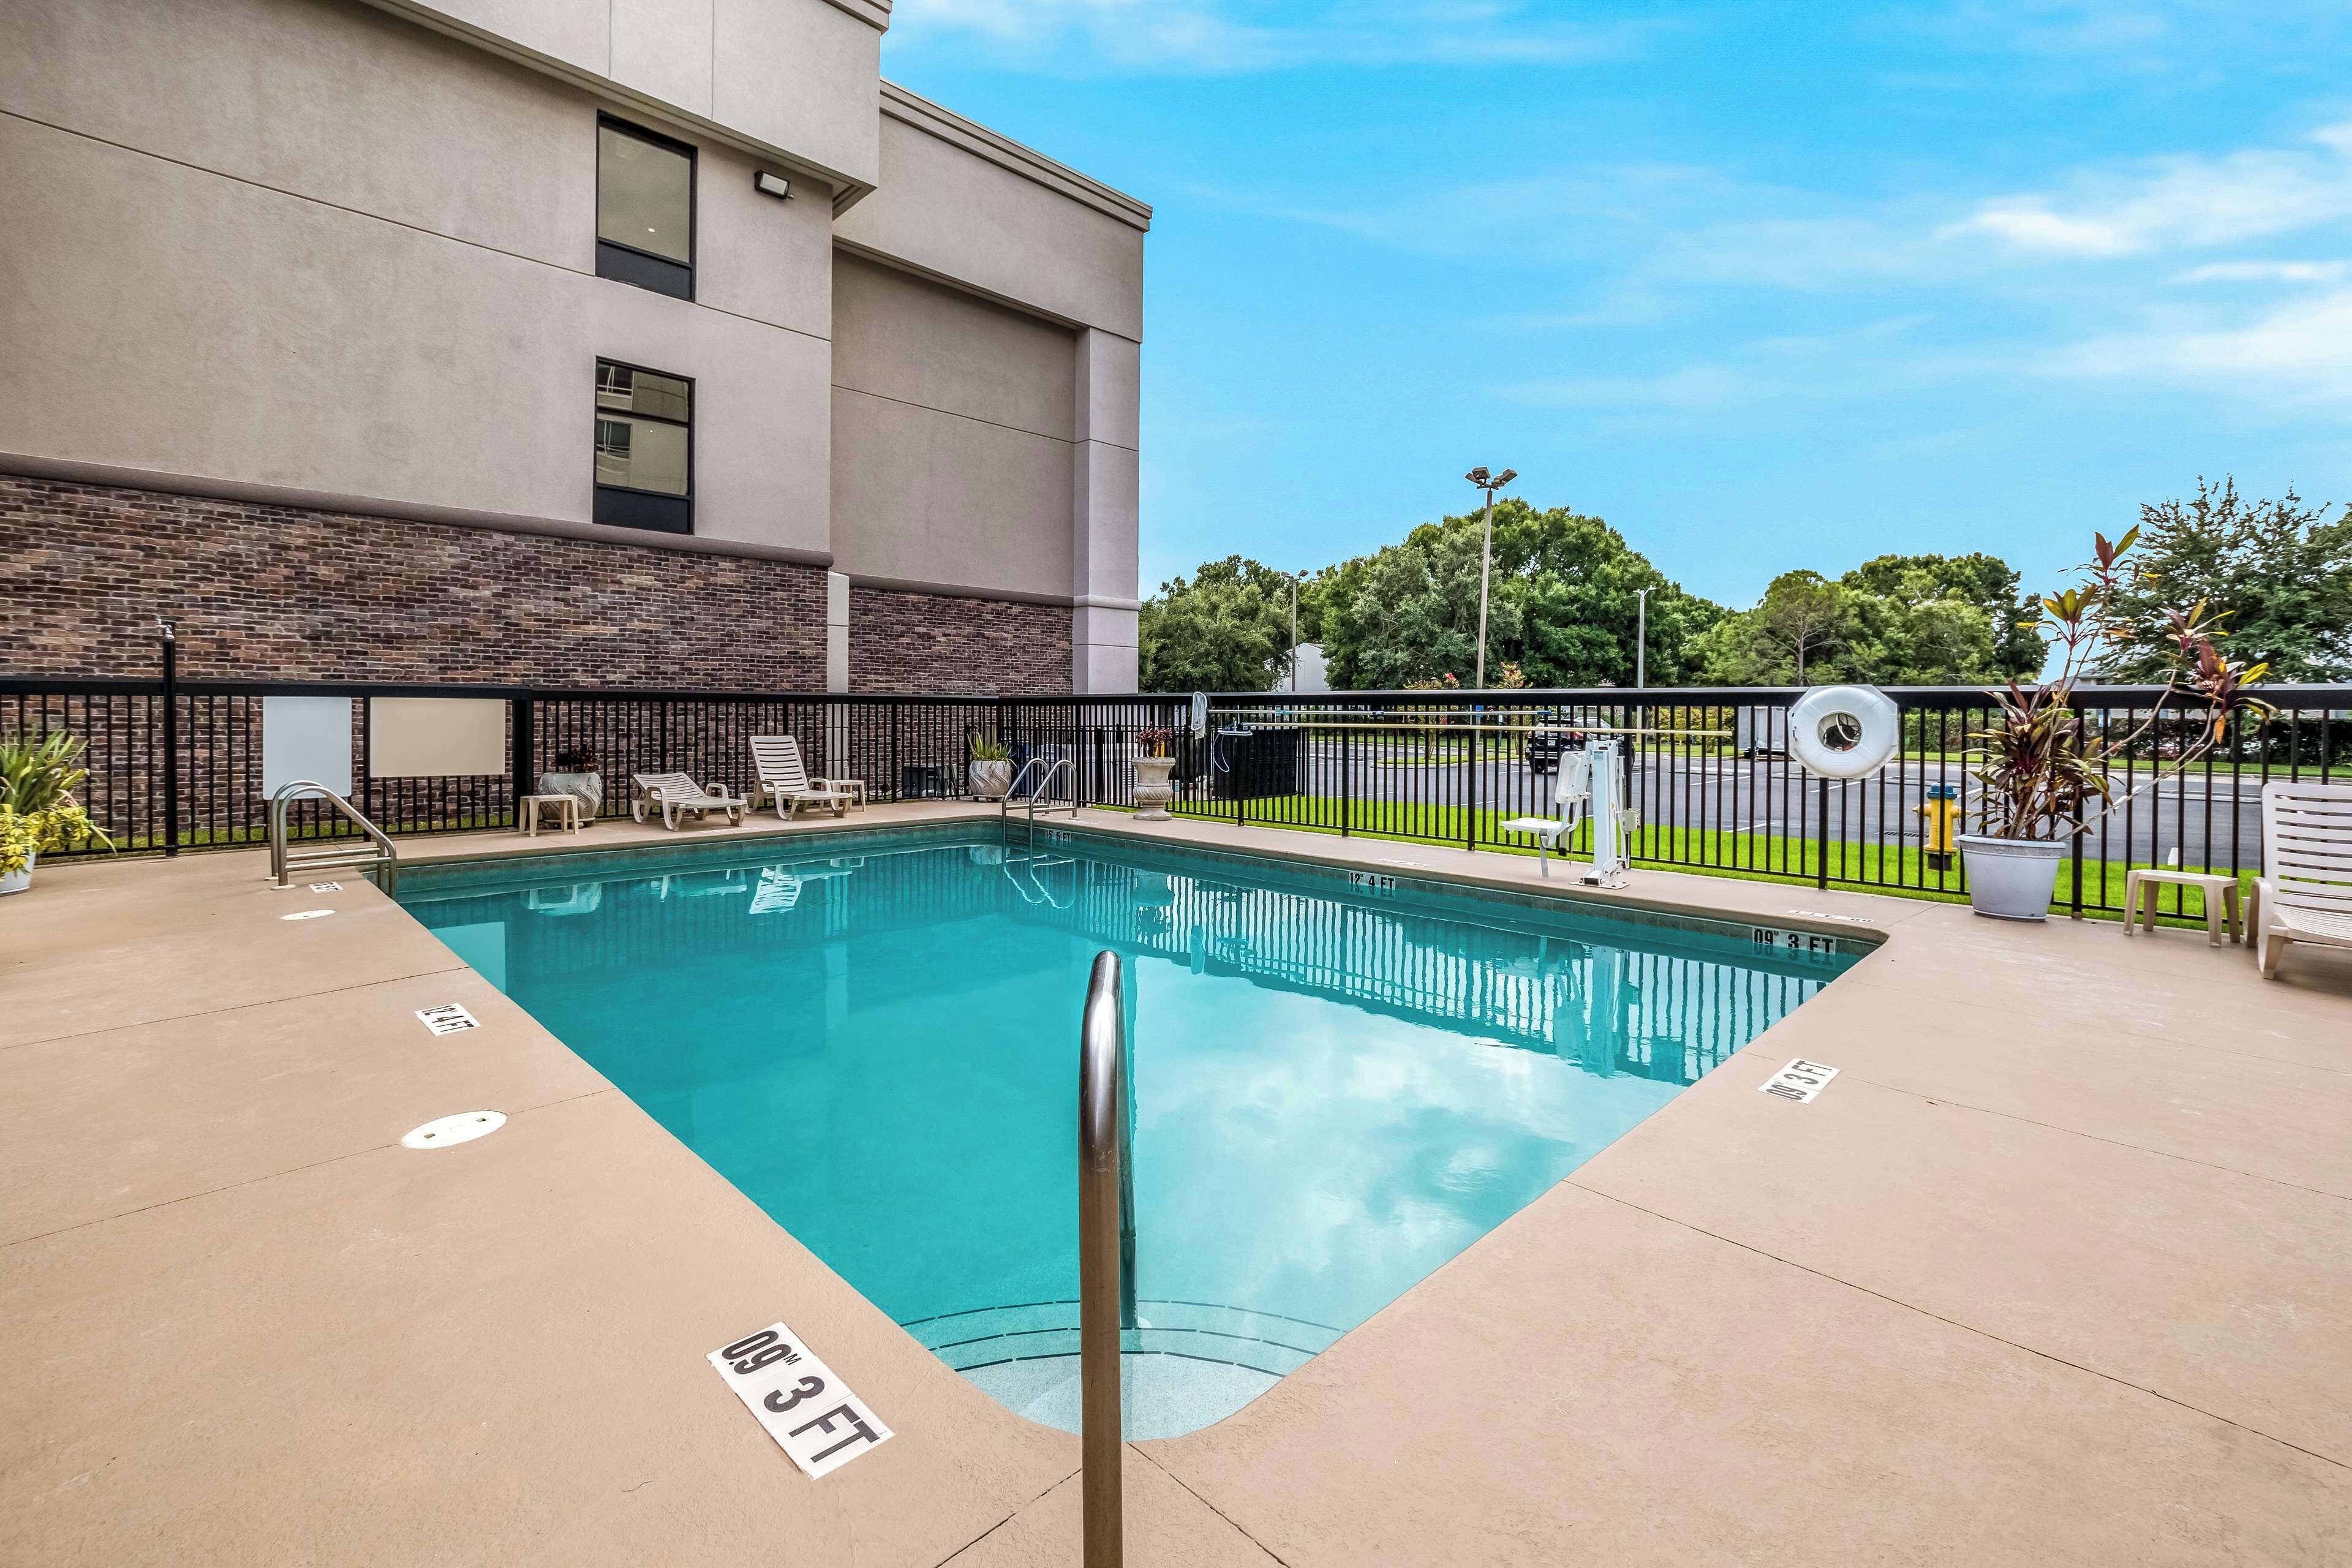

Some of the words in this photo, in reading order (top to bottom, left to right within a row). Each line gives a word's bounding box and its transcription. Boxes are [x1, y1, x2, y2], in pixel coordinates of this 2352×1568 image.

[1368, 875, 1376, 886] 4
[1381, 876, 1395, 889] FT
[1788, 933, 1799, 949] 3
[1809, 936, 1833, 953] FT
[435, 1020, 474, 1032] FT
[1791, 1060, 1833, 1076] FT
[1783, 1073, 1819, 1085] 3
[763, 1376, 825, 1413] 3
[788, 1403, 880, 1463] FT
